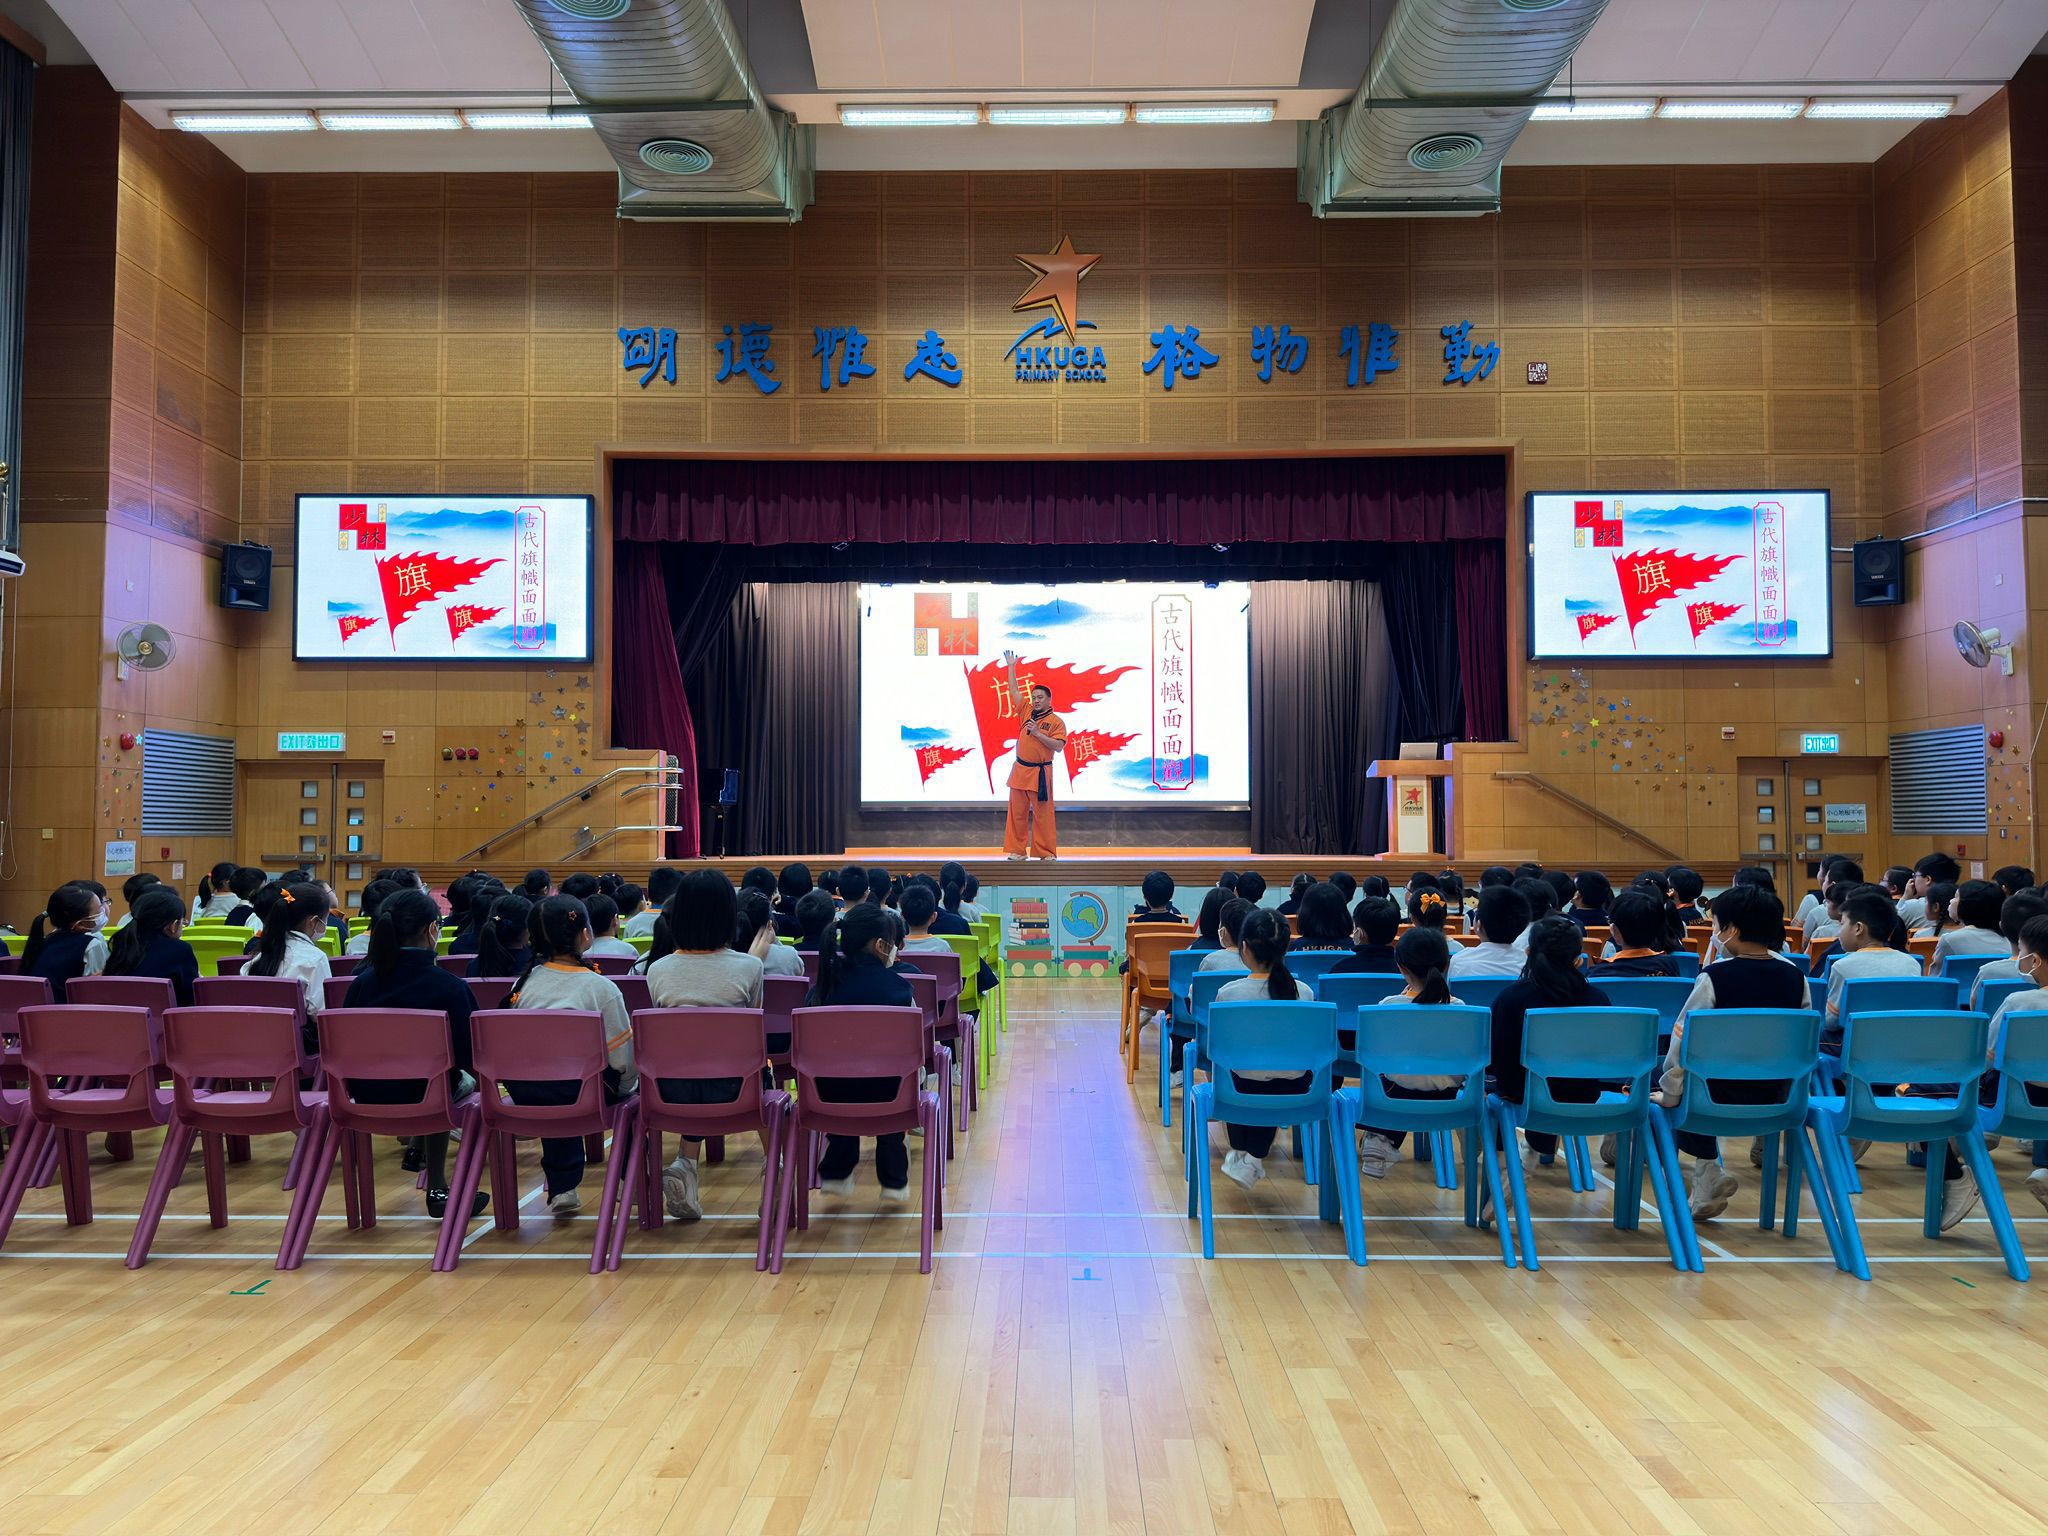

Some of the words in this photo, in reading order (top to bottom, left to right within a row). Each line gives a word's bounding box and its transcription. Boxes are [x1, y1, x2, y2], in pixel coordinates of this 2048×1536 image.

[1016, 346, 1106, 368] HKUGA
[1142, 320, 1500, 391] 格物惟勤
[1015, 370, 1059, 382] PRIMARY
[1066, 370, 1106, 382] SCHOOL
[394, 562, 431, 597] 旗
[1632, 559, 1671, 595] 旗
[453, 608, 474, 628] 旗
[1694, 605, 1714, 625] 旗
[1160, 603, 1186, 782] 古代旗幟面面觀
[281, 735, 305, 749] EXIT
[318, 735, 340, 749] 出口
[1071, 735, 1098, 762] 旗
[1805, 737, 1821, 752] EXIT
